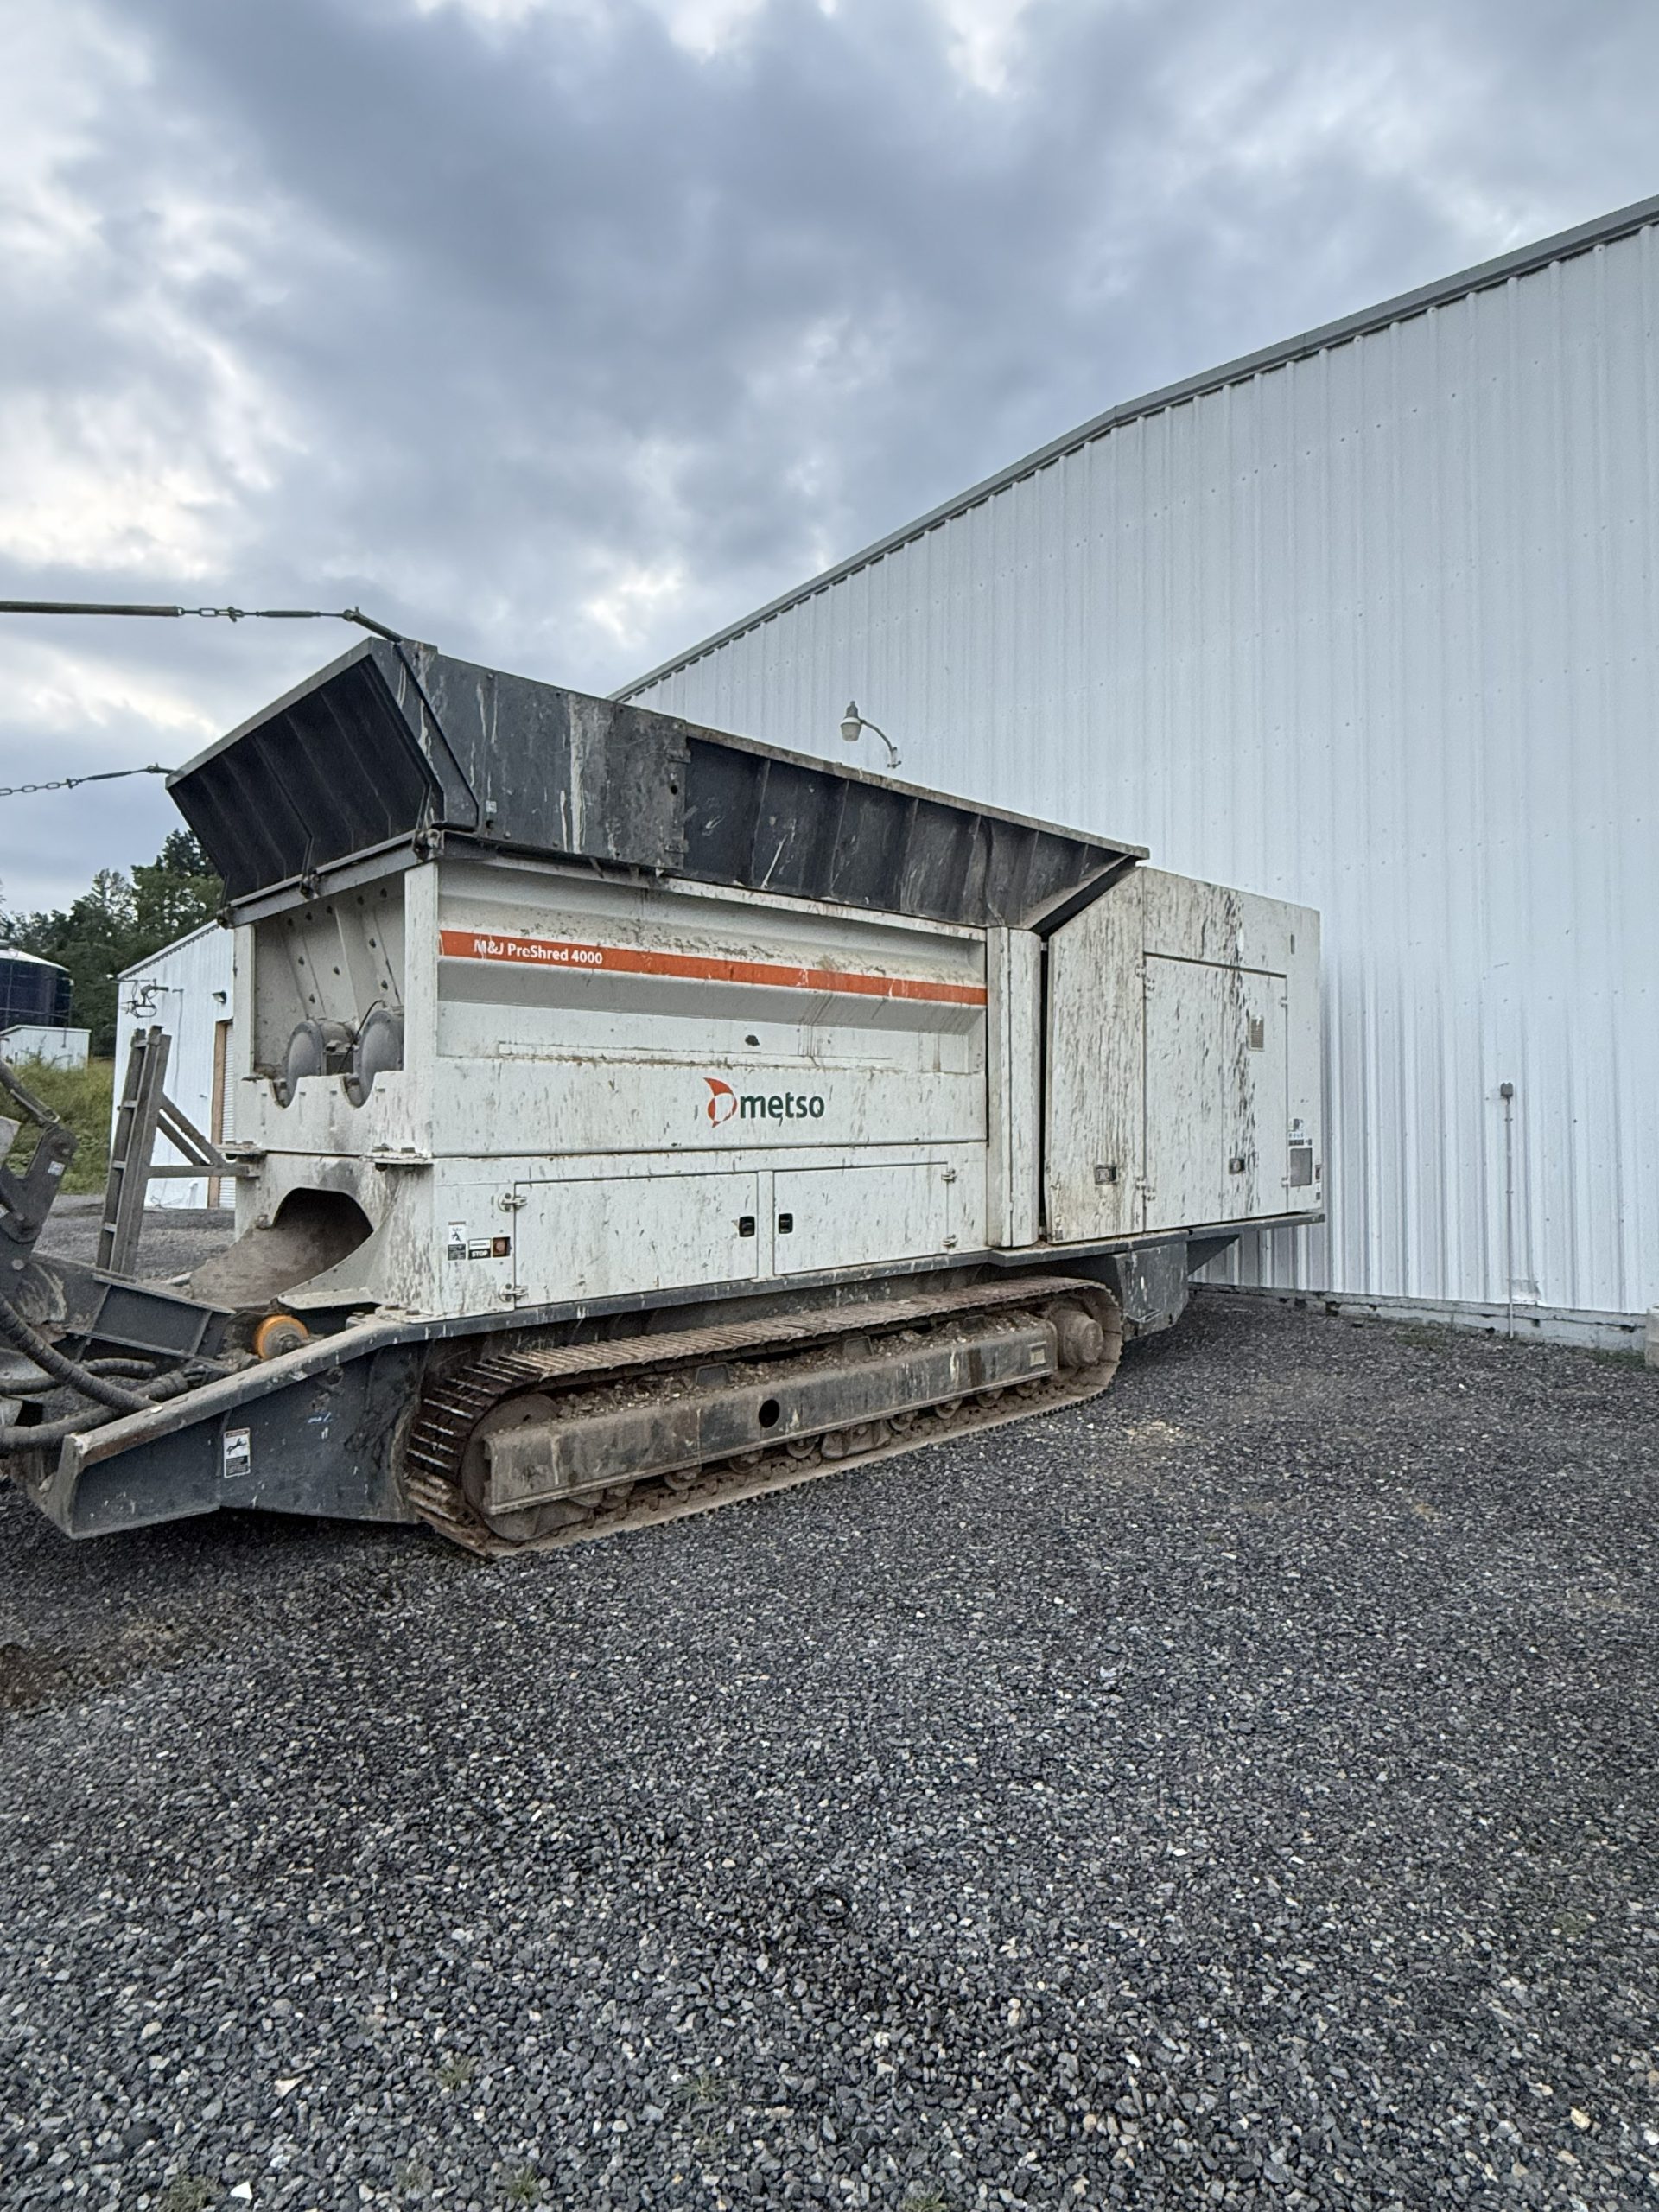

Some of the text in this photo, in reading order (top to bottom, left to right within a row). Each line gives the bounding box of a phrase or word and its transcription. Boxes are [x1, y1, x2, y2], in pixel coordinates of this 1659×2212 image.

[474, 938, 603, 964] M&J PreShred 4000
[740, 1091, 825, 1119] metso
[471, 1249, 489, 1258] STOP
